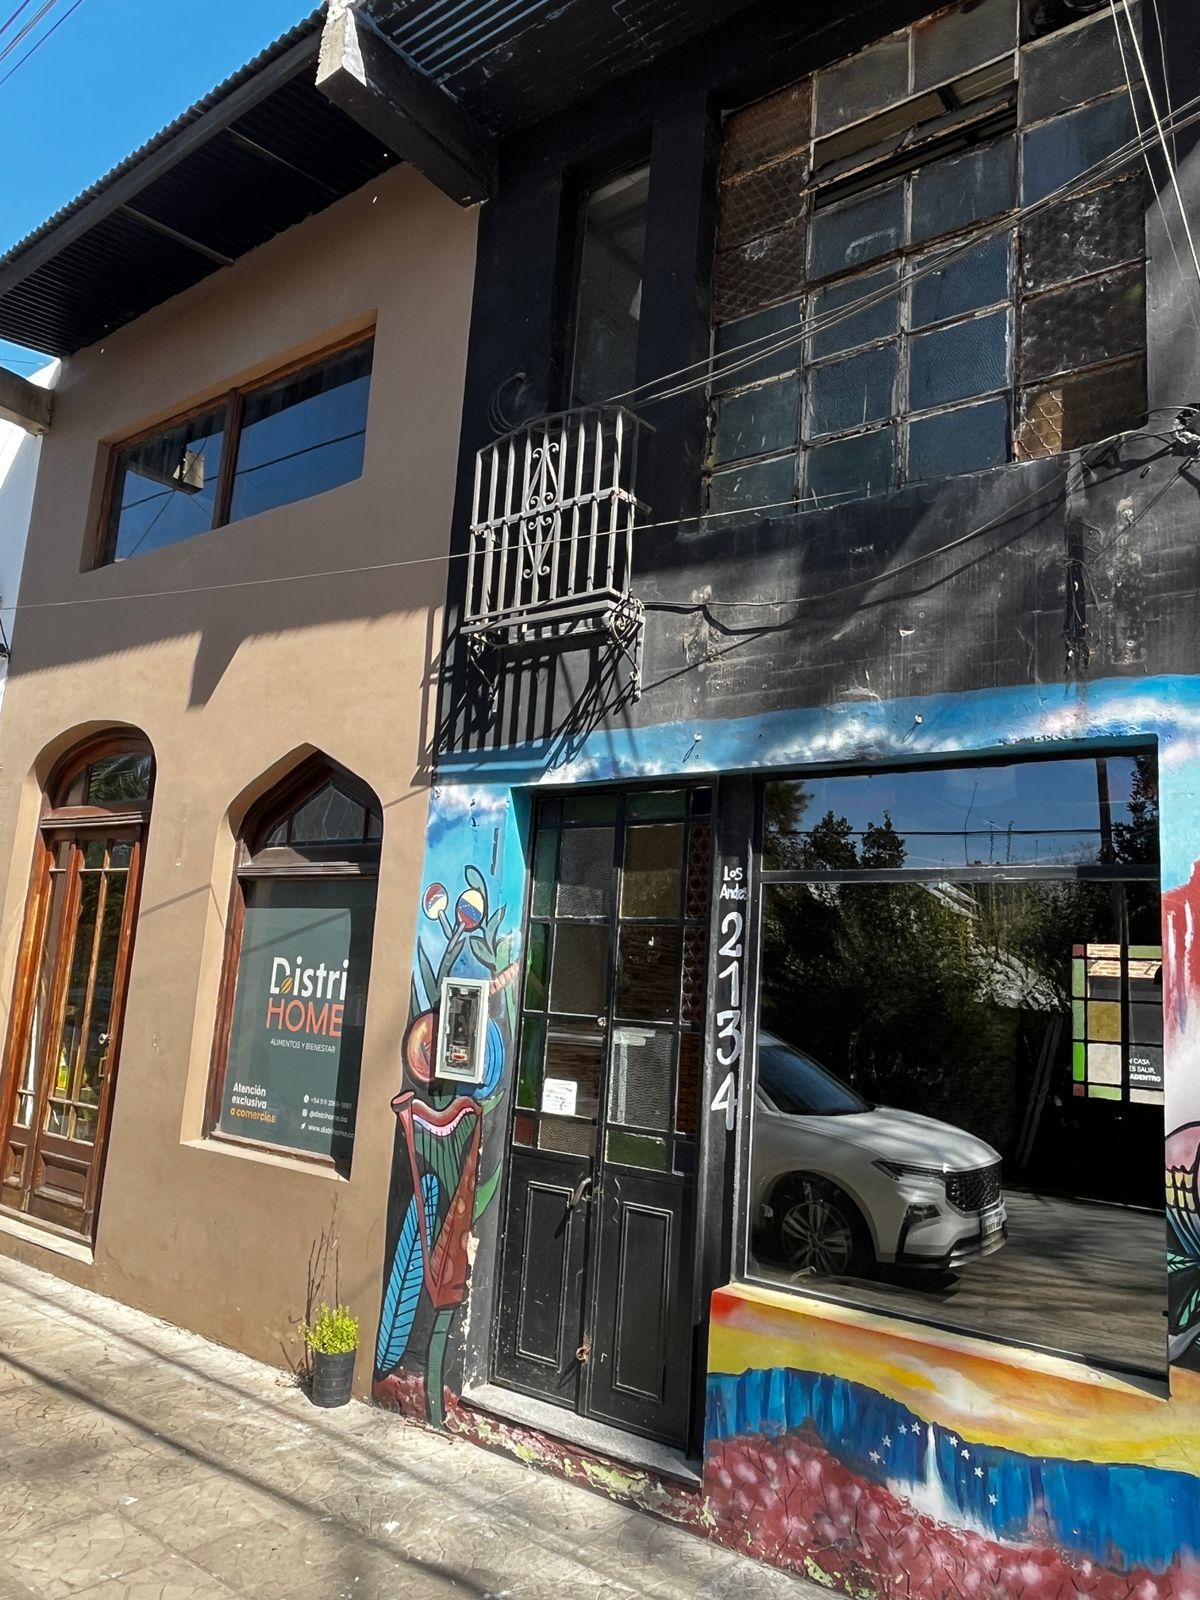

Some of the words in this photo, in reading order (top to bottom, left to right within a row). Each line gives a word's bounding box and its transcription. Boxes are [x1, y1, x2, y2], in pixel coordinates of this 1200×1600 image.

[270, 956, 349, 1001] Distri
[266, 997, 344, 1037] HOME
[711, 911, 743, 1131] 2134
[270, 1038, 301, 1049] ALIMENTOS
[305, 1042, 336, 1053] BIENESTAR
[1130, 1074, 1161, 1083] ADENTRO
[233, 1082, 267, 1097] Atención
[231, 1095, 267, 1109] exclusiva
[230, 1108, 236, 1116] a
[236, 1109, 276, 1123] comercios
